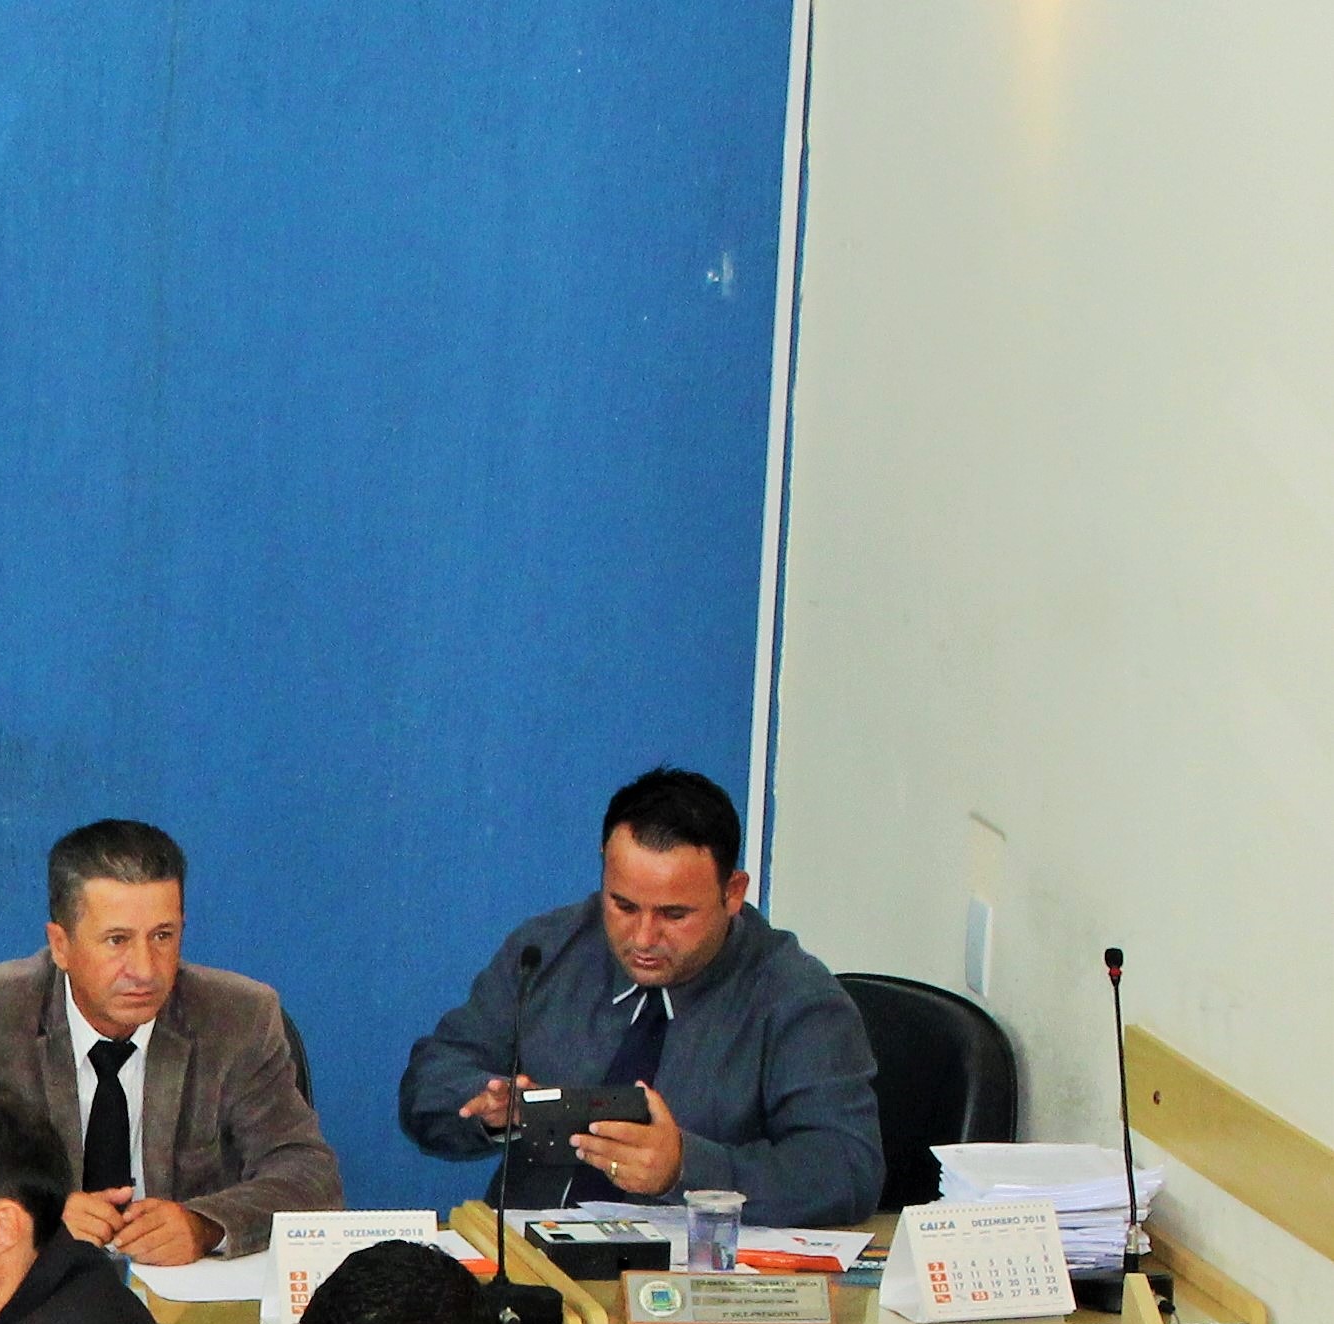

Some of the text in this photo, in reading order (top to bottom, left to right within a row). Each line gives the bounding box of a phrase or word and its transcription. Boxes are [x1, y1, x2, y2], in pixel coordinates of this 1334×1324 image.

[920, 1215, 1046, 1231] CAIXA DEZEMBRO 2018
[288, 1228, 424, 1238] CAIXA DEZEMBRO 2018
